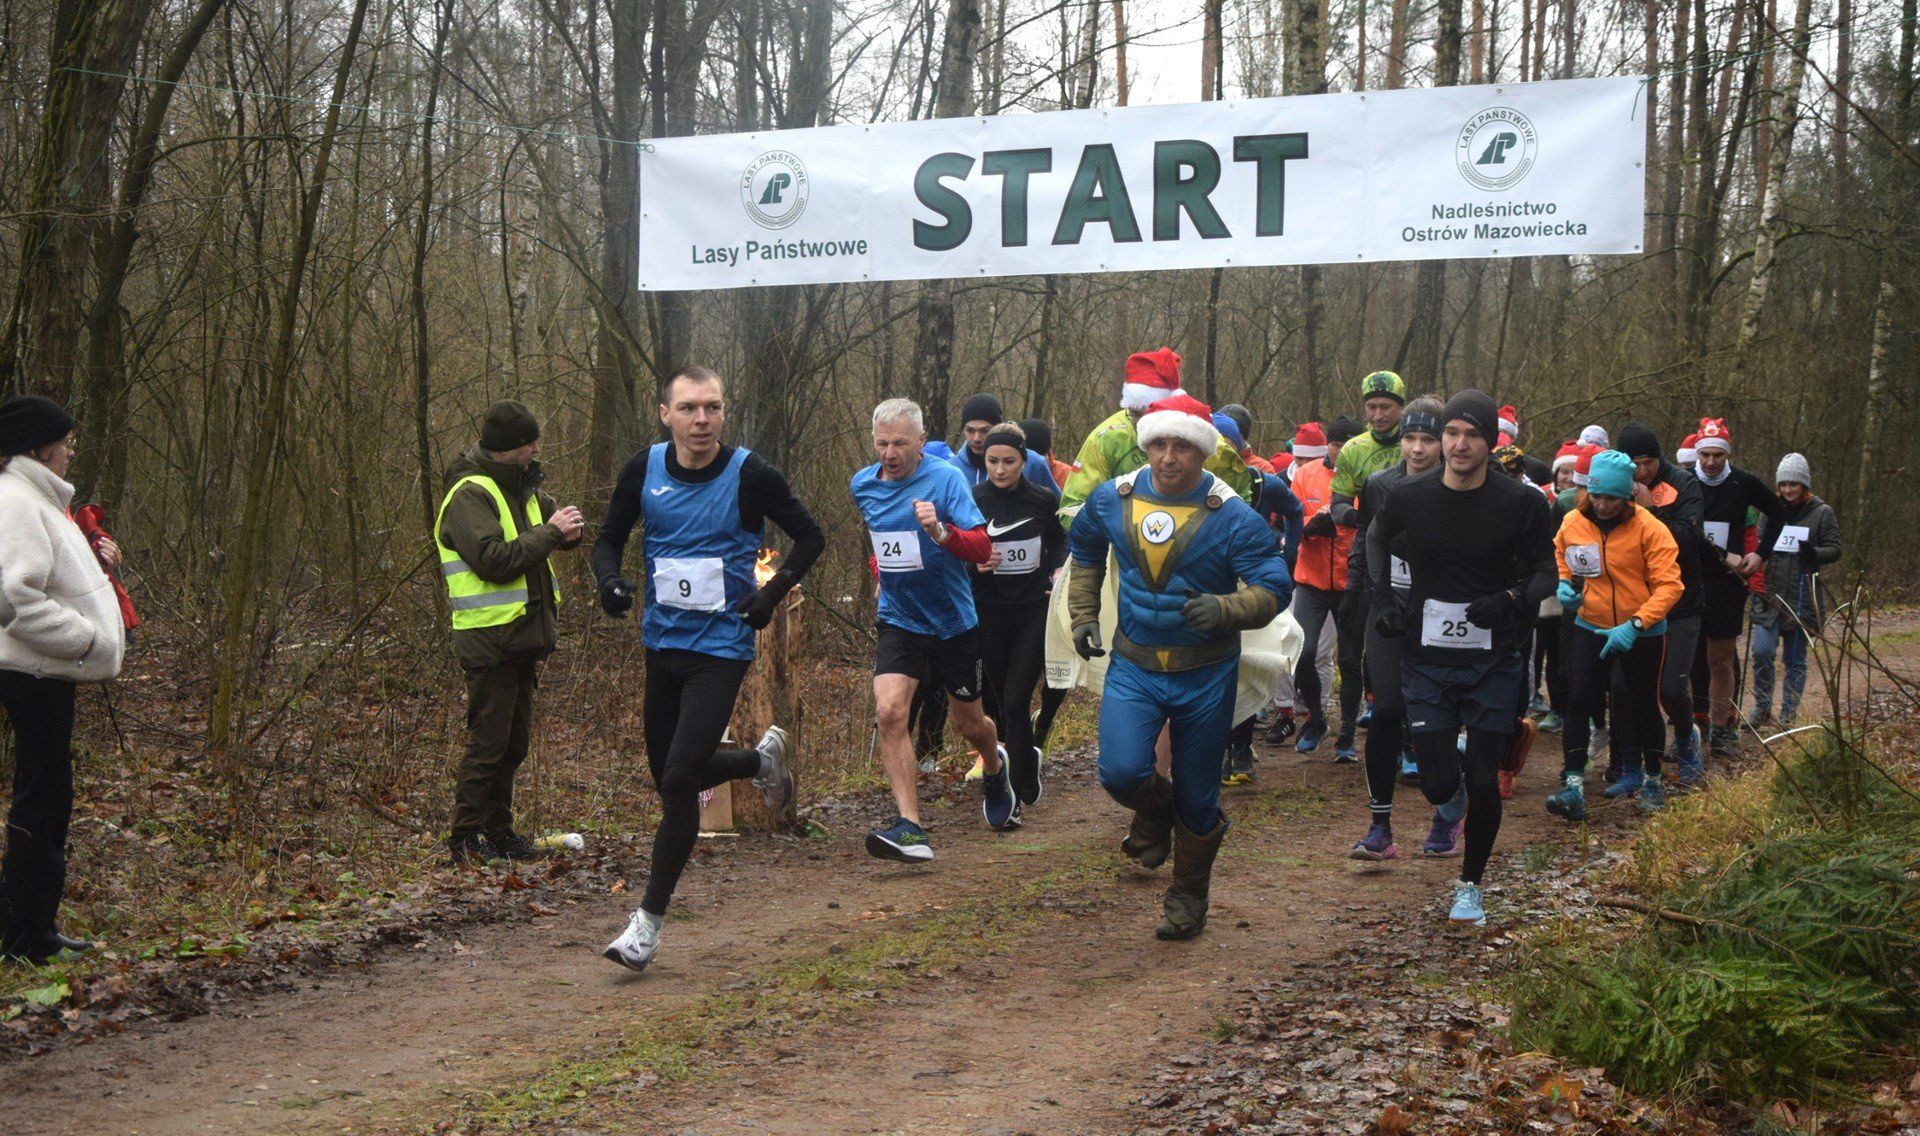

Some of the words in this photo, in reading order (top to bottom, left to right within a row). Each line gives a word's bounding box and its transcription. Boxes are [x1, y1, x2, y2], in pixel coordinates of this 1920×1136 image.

[1460, 121, 1477, 149] LASY
[744, 163, 757, 189] LASY
[912, 132, 1309, 252] START
[1431, 200, 1557, 220] Nadleśnictwo
[1401, 224, 1468, 242] Ostrów
[1474, 220, 1588, 239] Mazowiecka
[692, 244, 740, 268] Lasy
[746, 238, 868, 261] Państwowe
[881, 541, 902, 557] 24
[1781, 535, 1796, 546] 37
[1007, 548, 1027, 562] 30
[1399, 561, 1407, 575] 1
[678, 579, 692, 598] 9
[1442, 620, 1468, 638] 25
